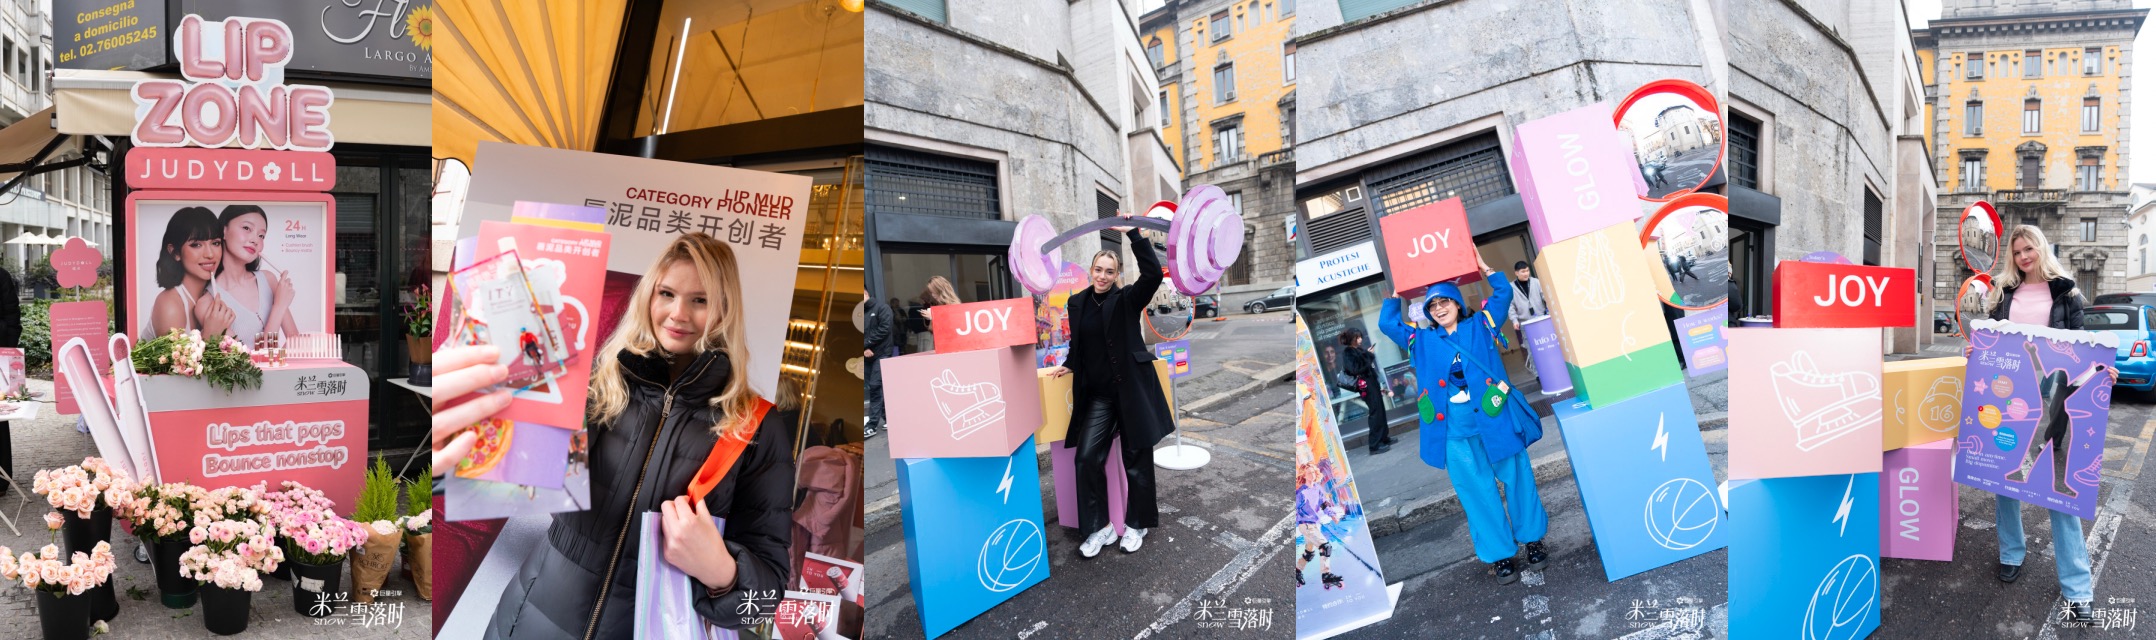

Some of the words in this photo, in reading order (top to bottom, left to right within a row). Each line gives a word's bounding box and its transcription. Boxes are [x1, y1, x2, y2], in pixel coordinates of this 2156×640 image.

[77, 0, 135, 24] Consegna
[74, 33, 81, 42] a
[84, 16, 138, 39] domicilio
[60, 49, 76, 63] tel.
[80, 26, 157, 57] 02.76005245
[182, 16, 290, 81] LIP
[365, 47, 417, 62] LARGO
[136, 82, 331, 148] ZONE
[1557, 133, 1600, 211] GLOW
[626, 187, 713, 209] CATEGORY
[717, 199, 791, 220] PIONEER
[725, 188, 750, 204] LIP
[754, 192, 794, 209] MUD
[1407, 228, 1450, 258] JOY
[1319, 251, 1360, 269] PROTESI
[1317, 263, 1371, 285] ACUSTICHE
[1813, 274, 1890, 307] JOY
[956, 307, 1012, 336] JOY
[2097, 390, 2109, 402] 10
[1930, 404, 1954, 423] 16
[209, 425, 251, 448] Lips
[255, 423, 293, 441] that
[298, 423, 342, 443] pops
[205, 455, 272, 475] Bounce
[276, 448, 345, 467] nonstop
[1899, 467, 1920, 542] GLOW
